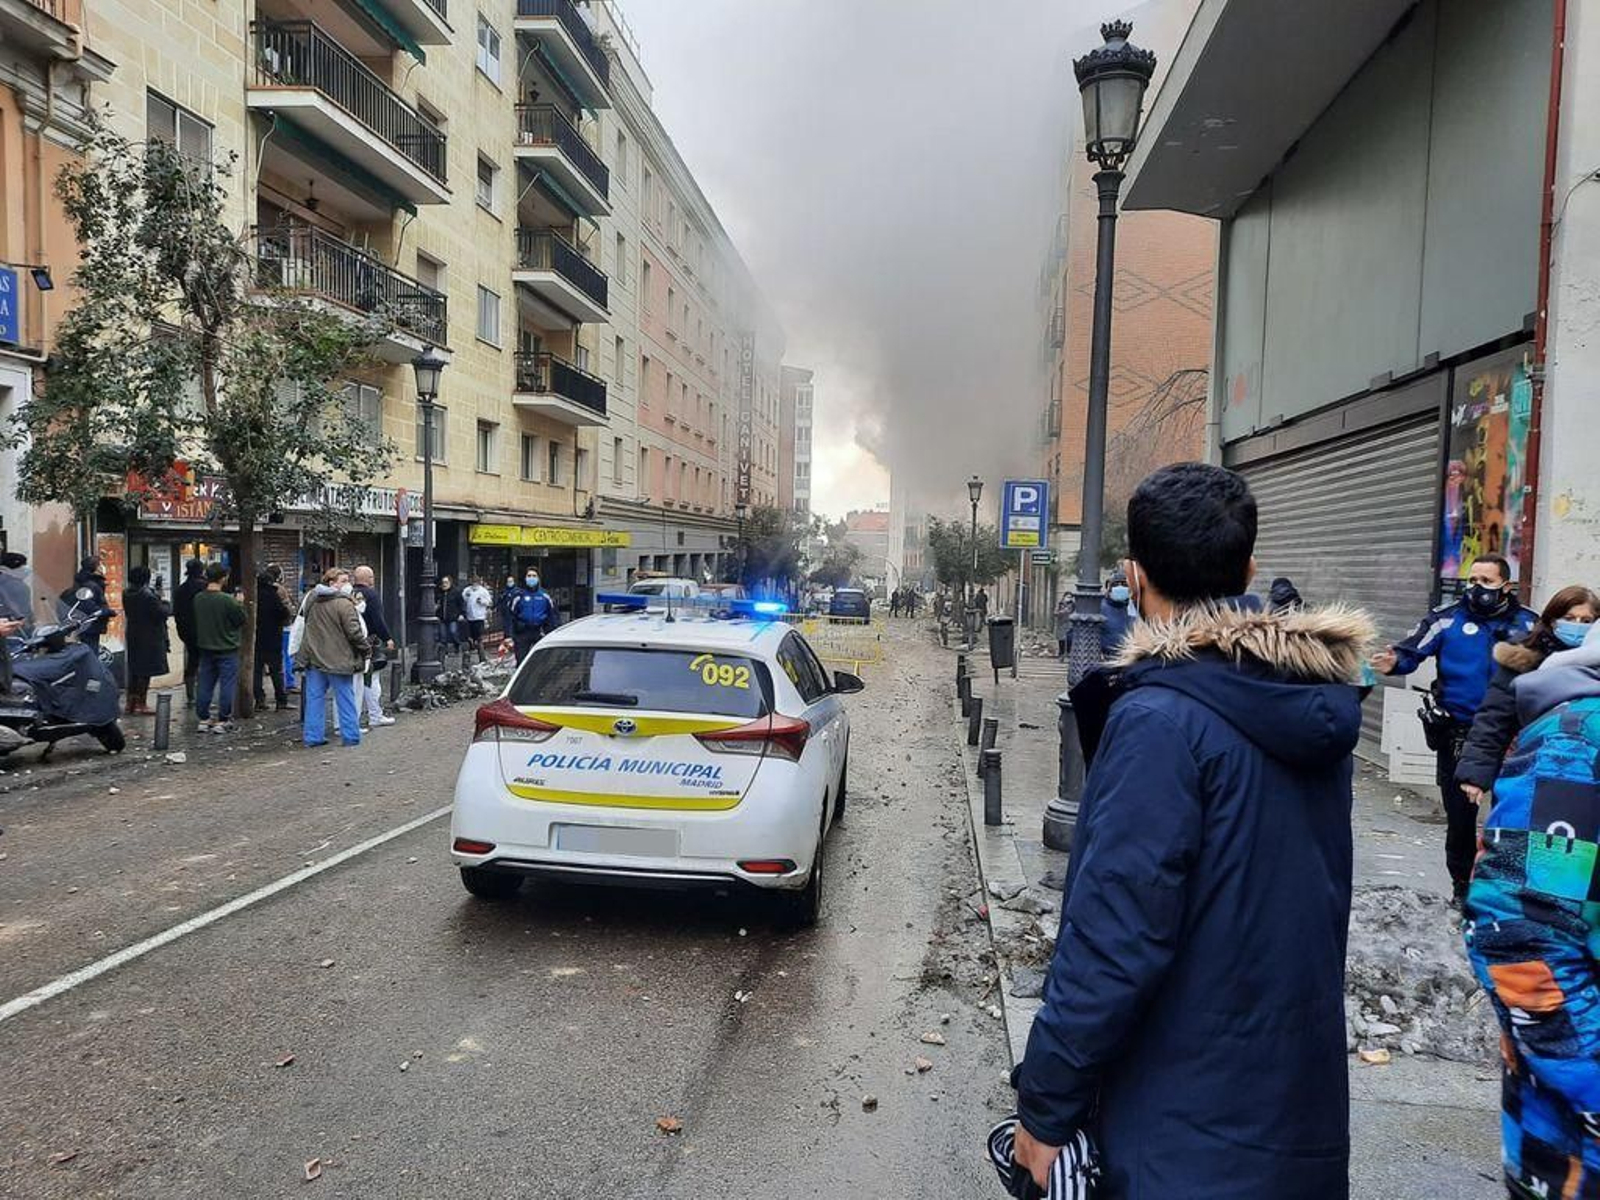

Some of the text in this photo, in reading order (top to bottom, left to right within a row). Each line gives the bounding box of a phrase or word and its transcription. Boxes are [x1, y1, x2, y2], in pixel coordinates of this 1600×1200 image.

[1013, 487, 1038, 511] P
[702, 662, 750, 689] 092
[618, 759, 722, 779] MUNICIPAL
[679, 778, 723, 789] MADRID
